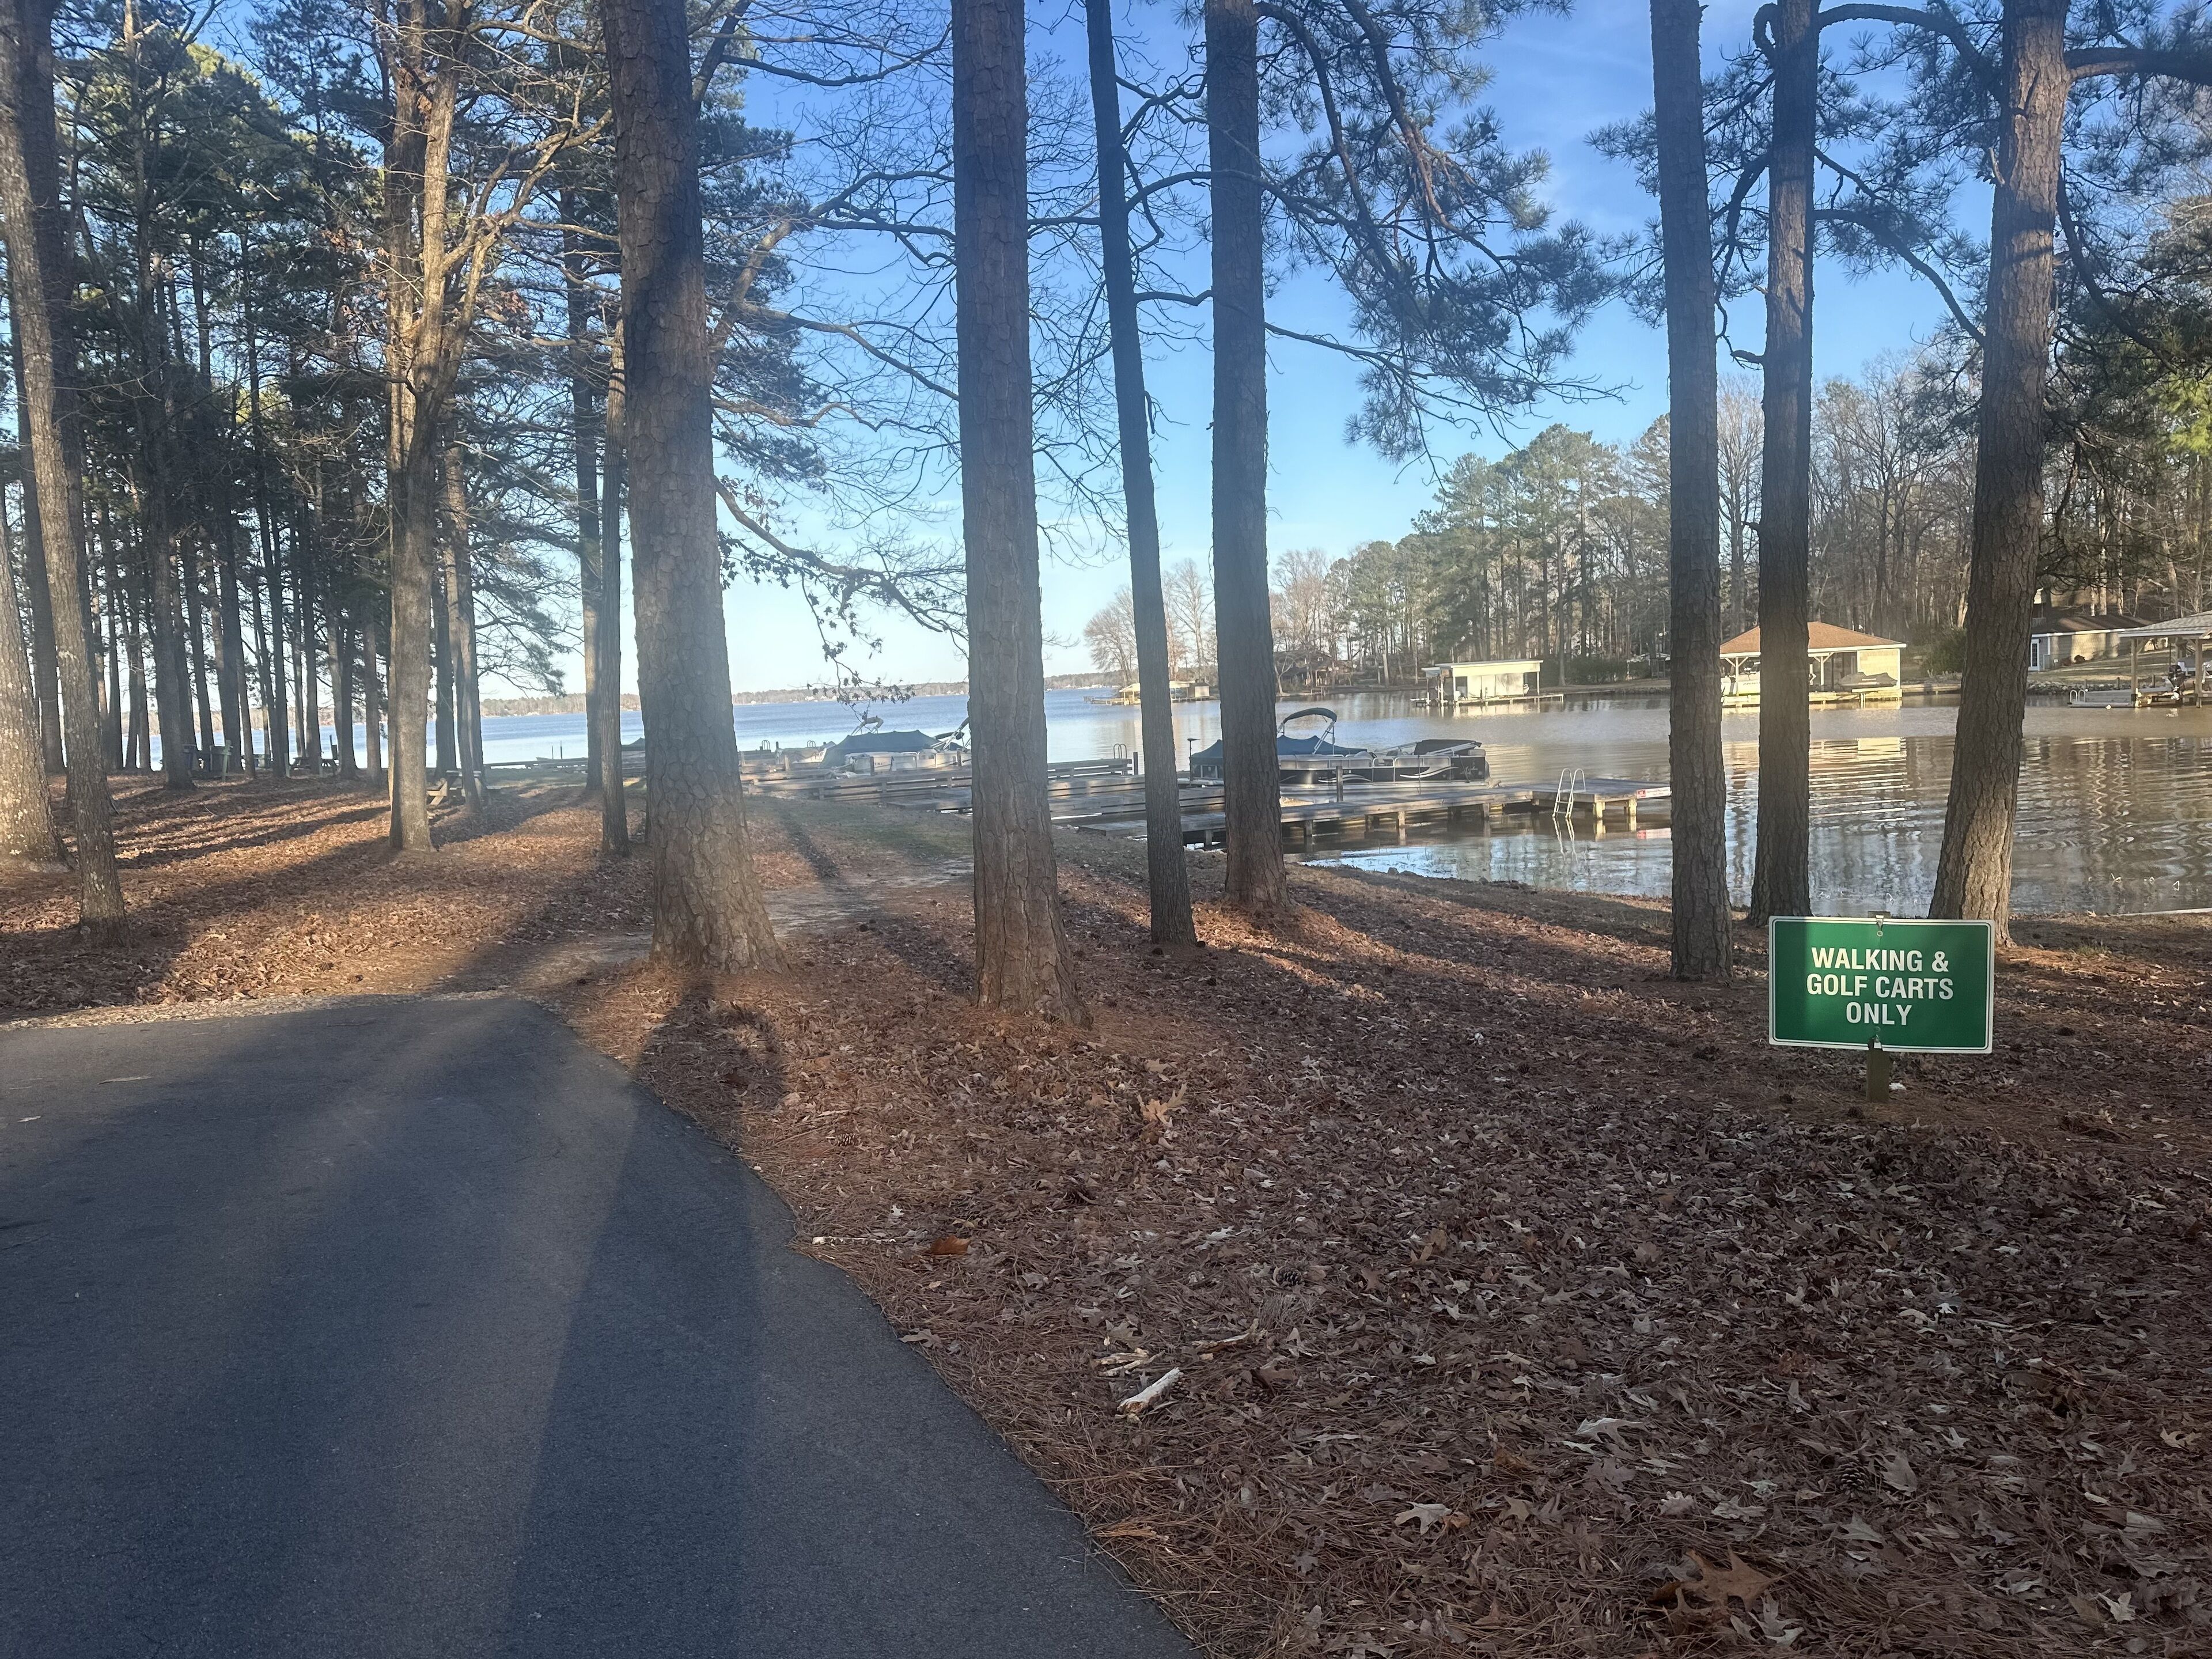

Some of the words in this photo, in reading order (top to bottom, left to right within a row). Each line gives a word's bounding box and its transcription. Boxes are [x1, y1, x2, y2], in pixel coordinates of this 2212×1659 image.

[1811, 947, 1922, 972] WALKING
[1931, 950, 1949, 972] &
[1806, 974, 1868, 996] GOLF
[1875, 976, 1953, 1000] CARTS
[1846, 1002, 1912, 1025] ONLY
